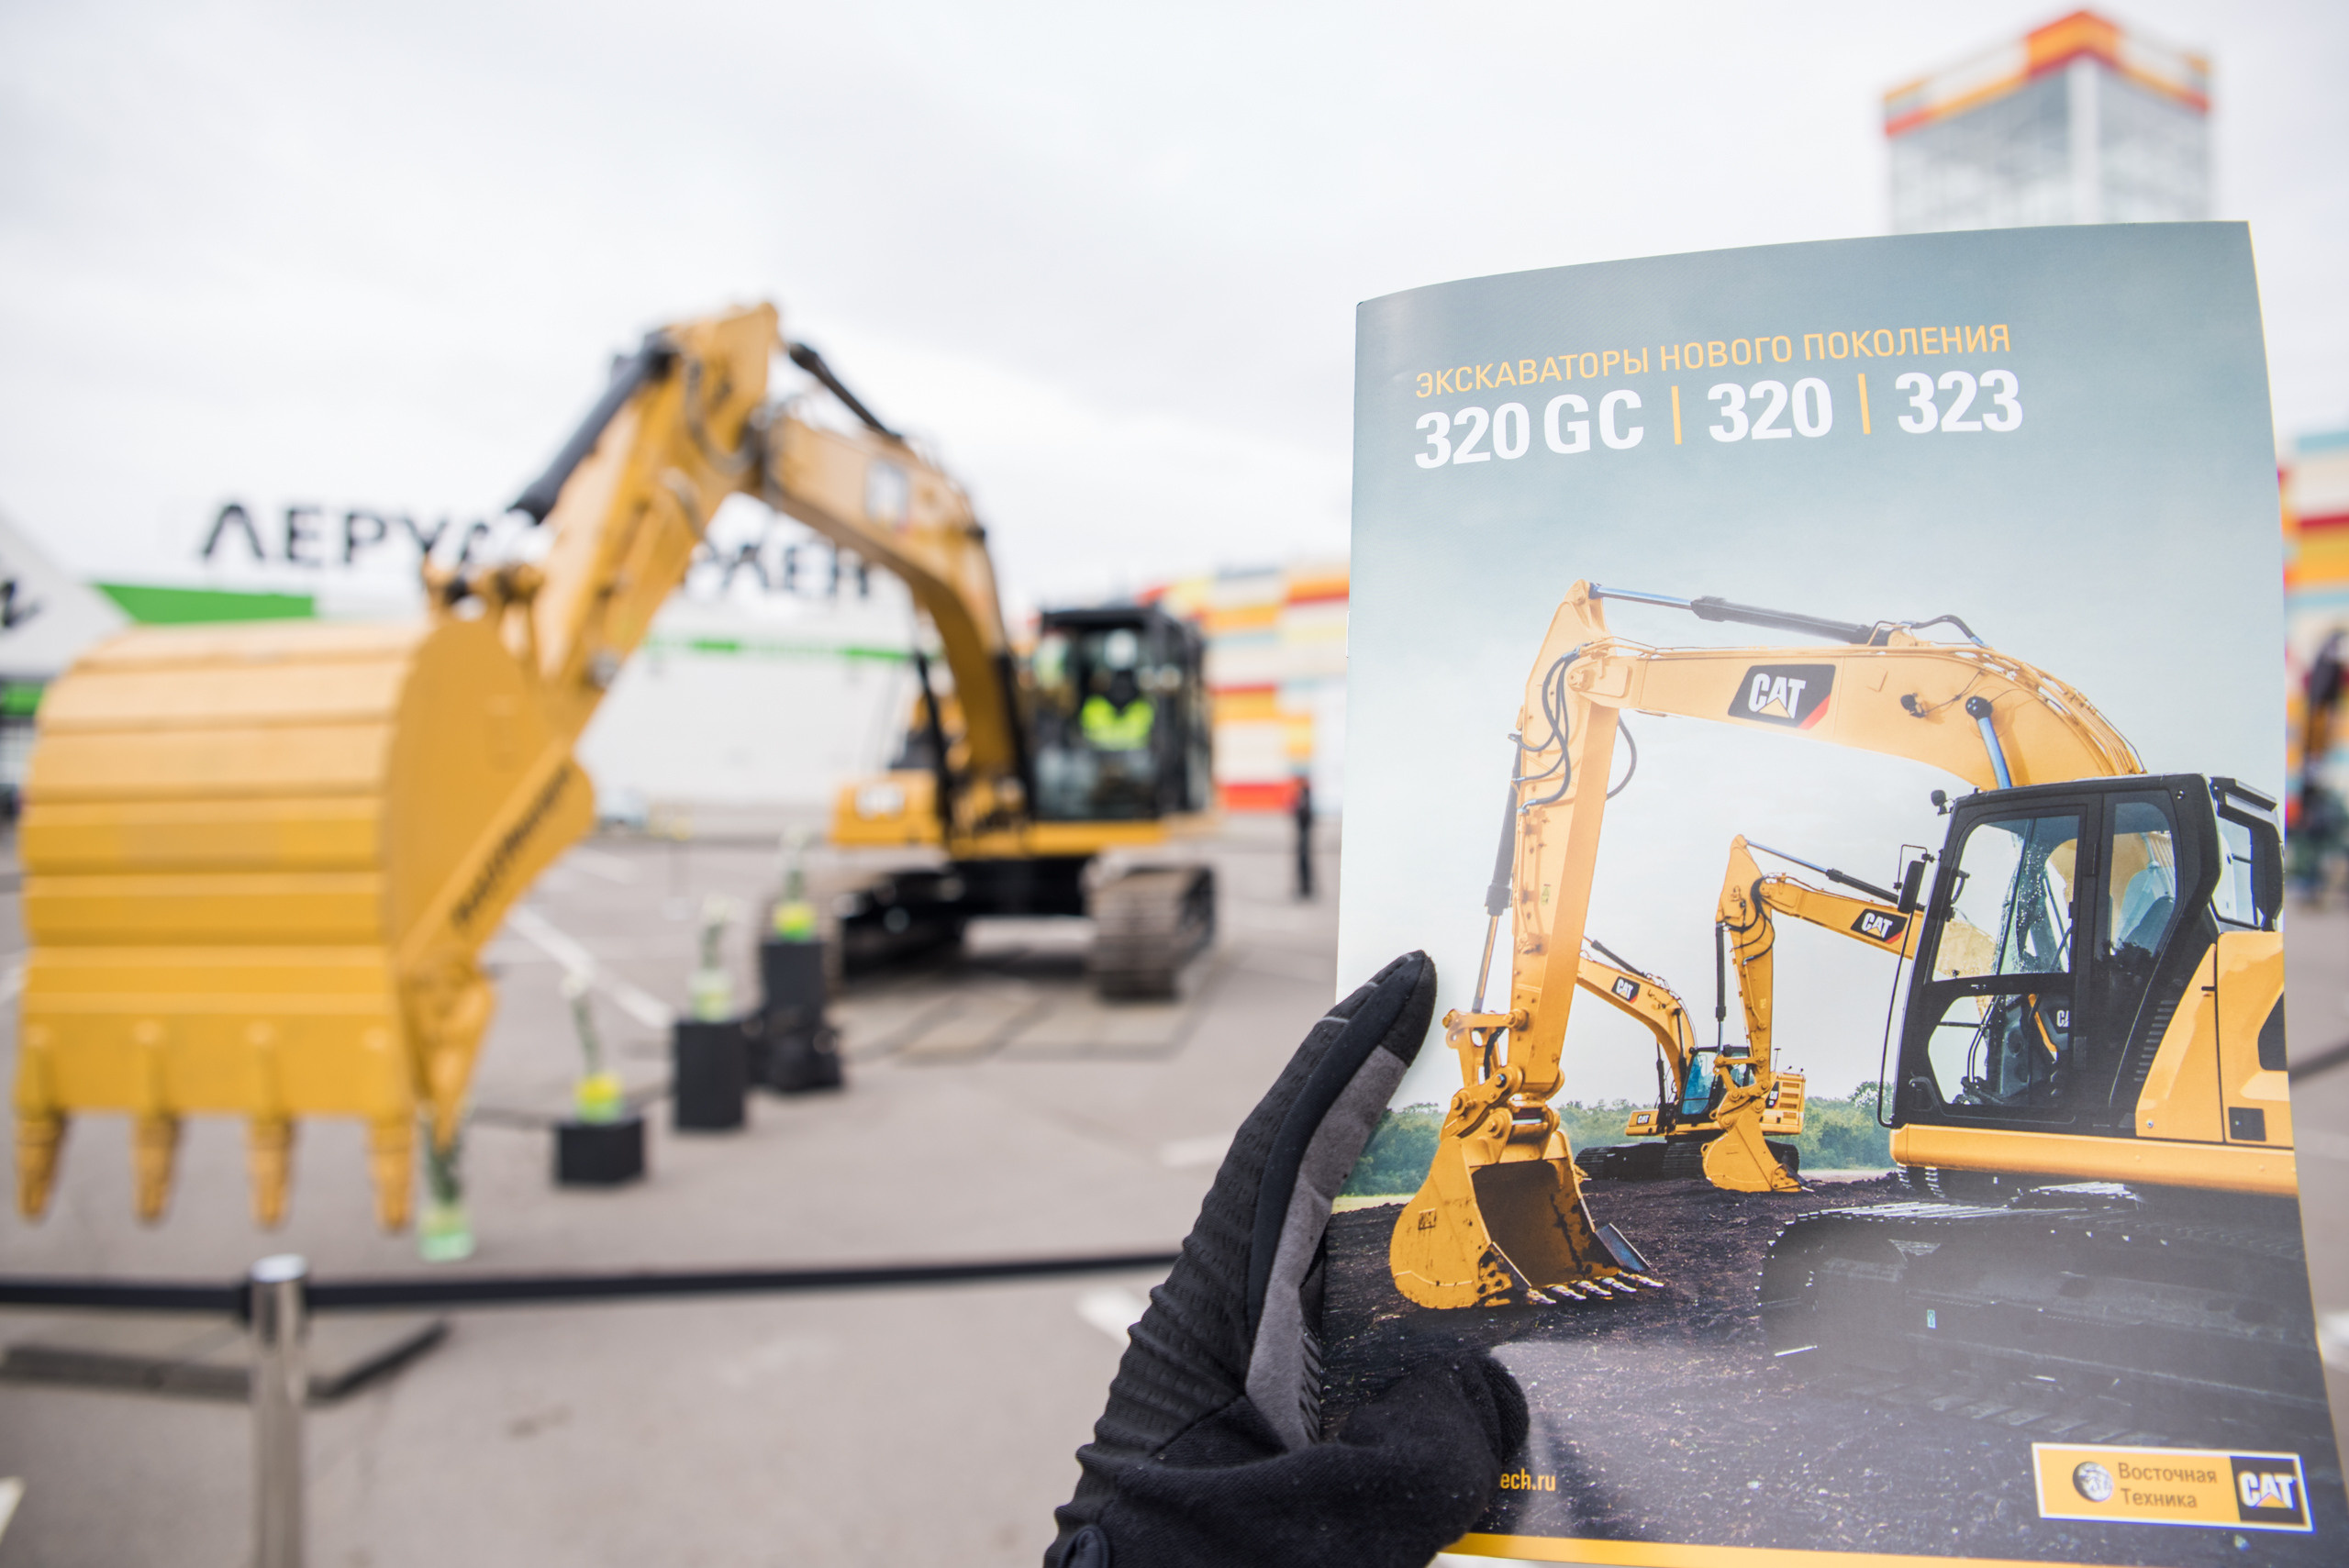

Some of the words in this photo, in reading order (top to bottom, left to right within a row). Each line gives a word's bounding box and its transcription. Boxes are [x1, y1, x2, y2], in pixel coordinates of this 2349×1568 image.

[1415, 346, 1650, 399] ЭКСКАВАТОРЫ
[1659, 334, 1793, 372] НОВОГО
[1803, 323, 2011, 361] ПОКОЛЕНИЯ
[1414, 406, 1531, 470] 320
[1543, 388, 1645, 455] GC
[1707, 376, 1834, 443] 320
[1894, 369, 2024, 435] 323
[1747, 672, 1807, 719] CAT
[1861, 912, 1894, 939] CAT
[1616, 978, 1634, 1000] CAT
[1499, 1467, 1557, 1492] ech.ru
[2117, 1461, 2219, 1485] Восточная
[2120, 1487, 2199, 1509] Техника
[2237, 1470, 2297, 1510] CAT
